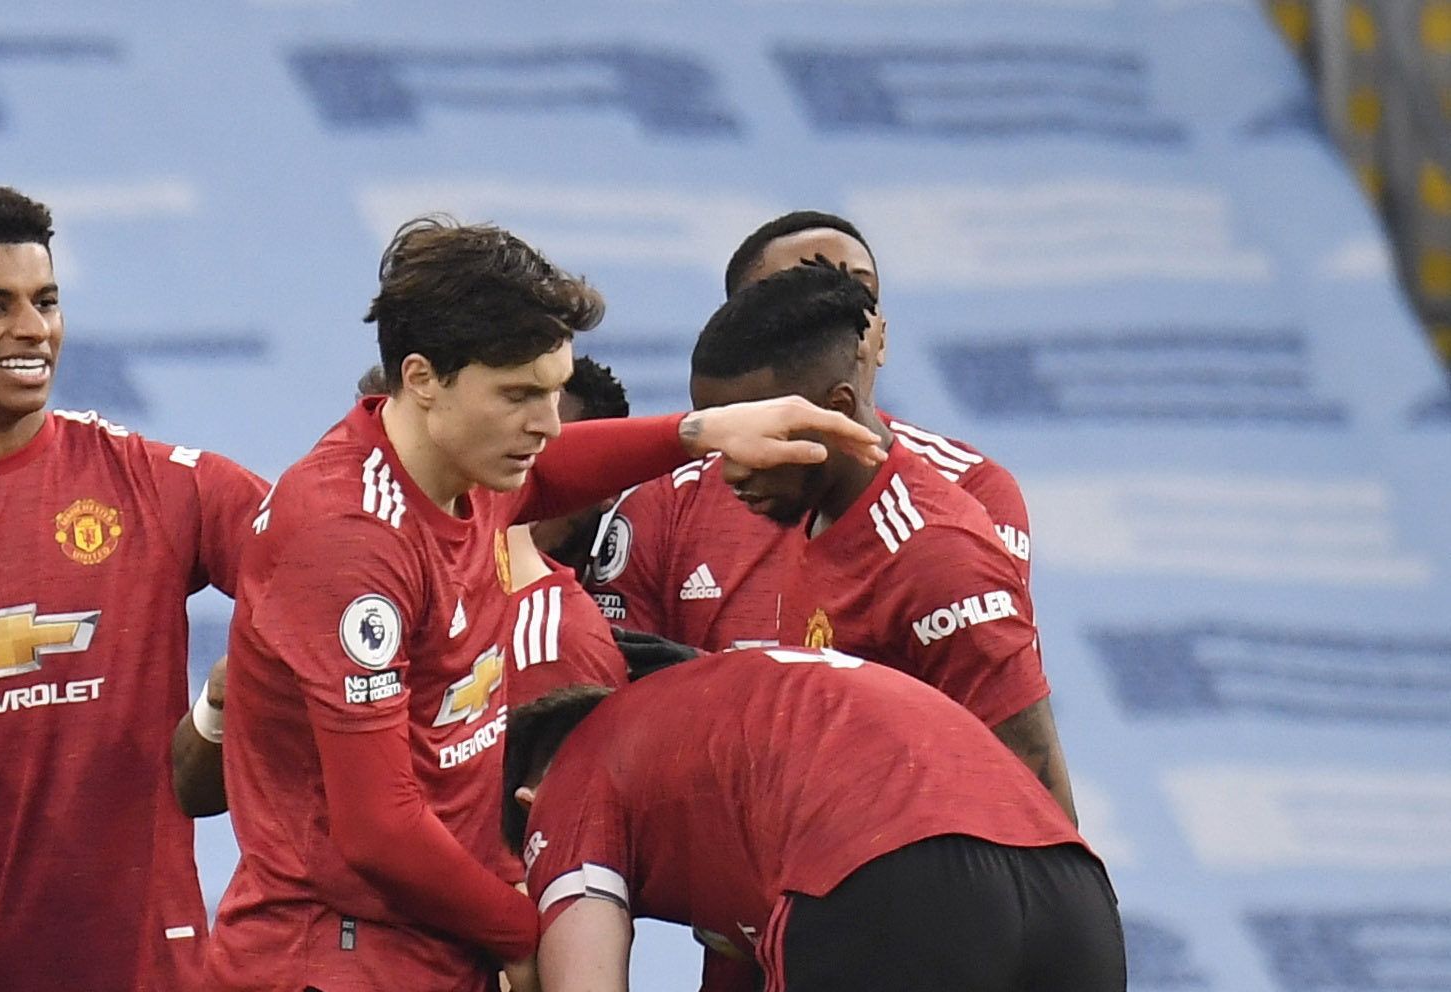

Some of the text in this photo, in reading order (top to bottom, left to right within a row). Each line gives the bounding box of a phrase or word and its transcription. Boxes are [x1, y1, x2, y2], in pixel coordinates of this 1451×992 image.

[679, 585, 722, 600] adidas
[911, 590, 1018, 646] KOHLER
[344, 675, 369, 691] No
